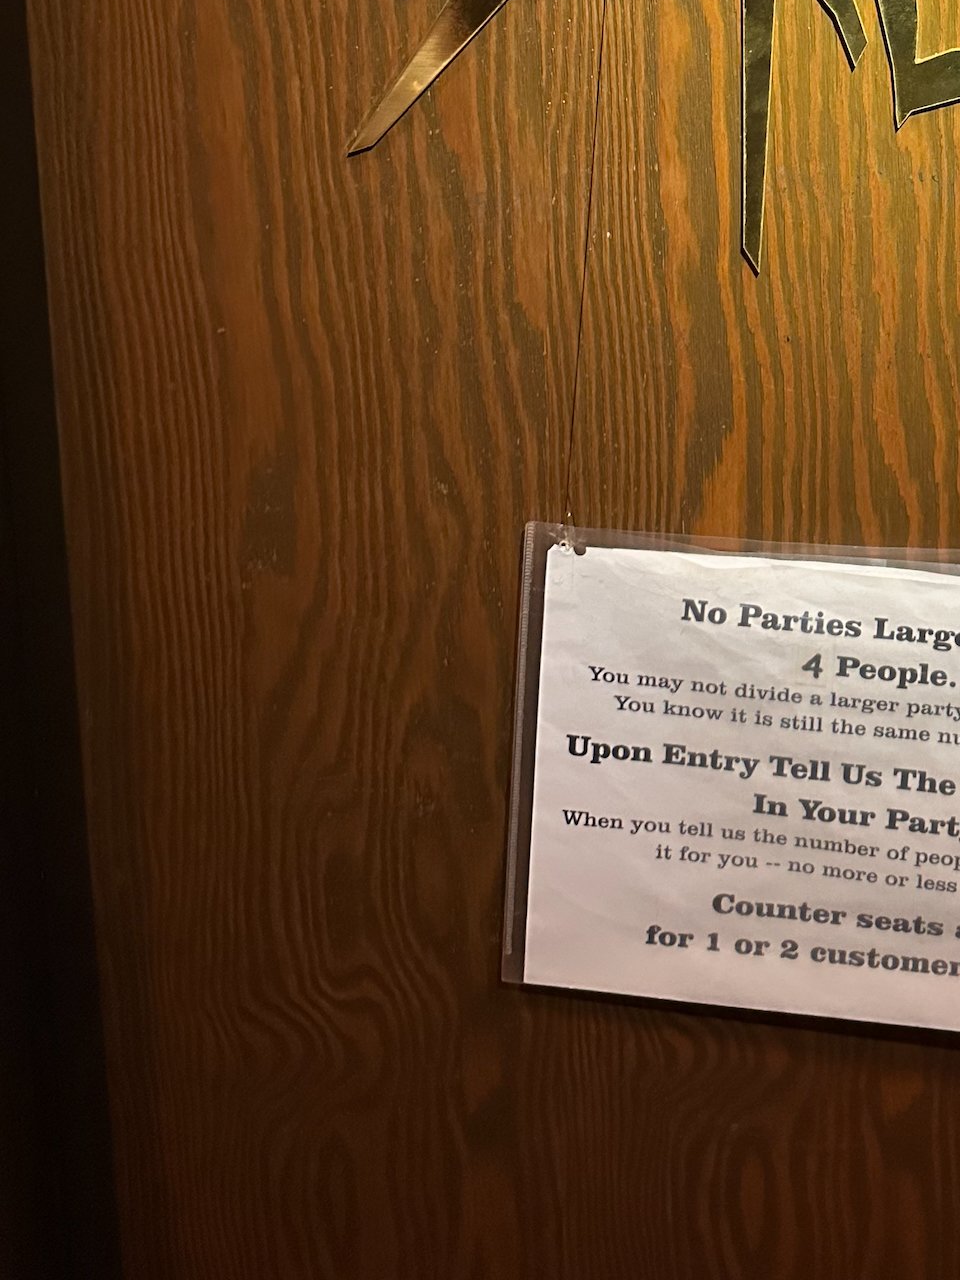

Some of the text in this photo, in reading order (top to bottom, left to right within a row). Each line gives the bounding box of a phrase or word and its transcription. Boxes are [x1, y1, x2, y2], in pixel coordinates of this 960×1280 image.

[680, 598, 728, 626] No
[736, 602, 862, 639] Parties
[587, 665, 631, 686] You
[636, 674, 685, 695] may
[690, 680, 728, 697] not
[734, 682, 803, 704] divide
[809, 694, 824, 707] a
[829, 691, 900, 715] larger
[801, 652, 957, 690] 4 People.
[613, 694, 656, 714] You
[662, 699, 724, 721] know
[730, 707, 747, 724] it
[754, 709, 773, 728] is
[779, 714, 823, 733] still
[830, 718, 867, 737] the
[872, 725, 931, 742] same
[565, 733, 654, 765] Upon
[661, 742, 761, 781] Entry
[768, 754, 831, 783] Tell
[840, 762, 883, 788] Us
[892, 767, 957, 797] The
[752, 792, 789, 818] In
[797, 798, 877, 828] Your
[561, 808, 624, 830] When
[629, 819, 672, 836] you
[678, 819, 713, 838] tell
[720, 827, 746, 842] us
[752, 828, 788, 846] the
[794, 836, 880, 858] number
[886, 845, 911, 862] of
[655, 843, 673, 861] it
[678, 845, 712, 864] for
[717, 853, 759, 870] you
[787, 860, 816, 875] no
[821, 864, 878, 884] more
[884, 874, 910, 888] or
[915, 873, 958, 894] less
[711, 893, 848, 926] Counter
[856, 912, 944, 937] seats
[644, 924, 695, 949] for
[706, 932, 721, 952] 1
[734, 938, 771, 957] or
[779, 939, 799, 961] 2
